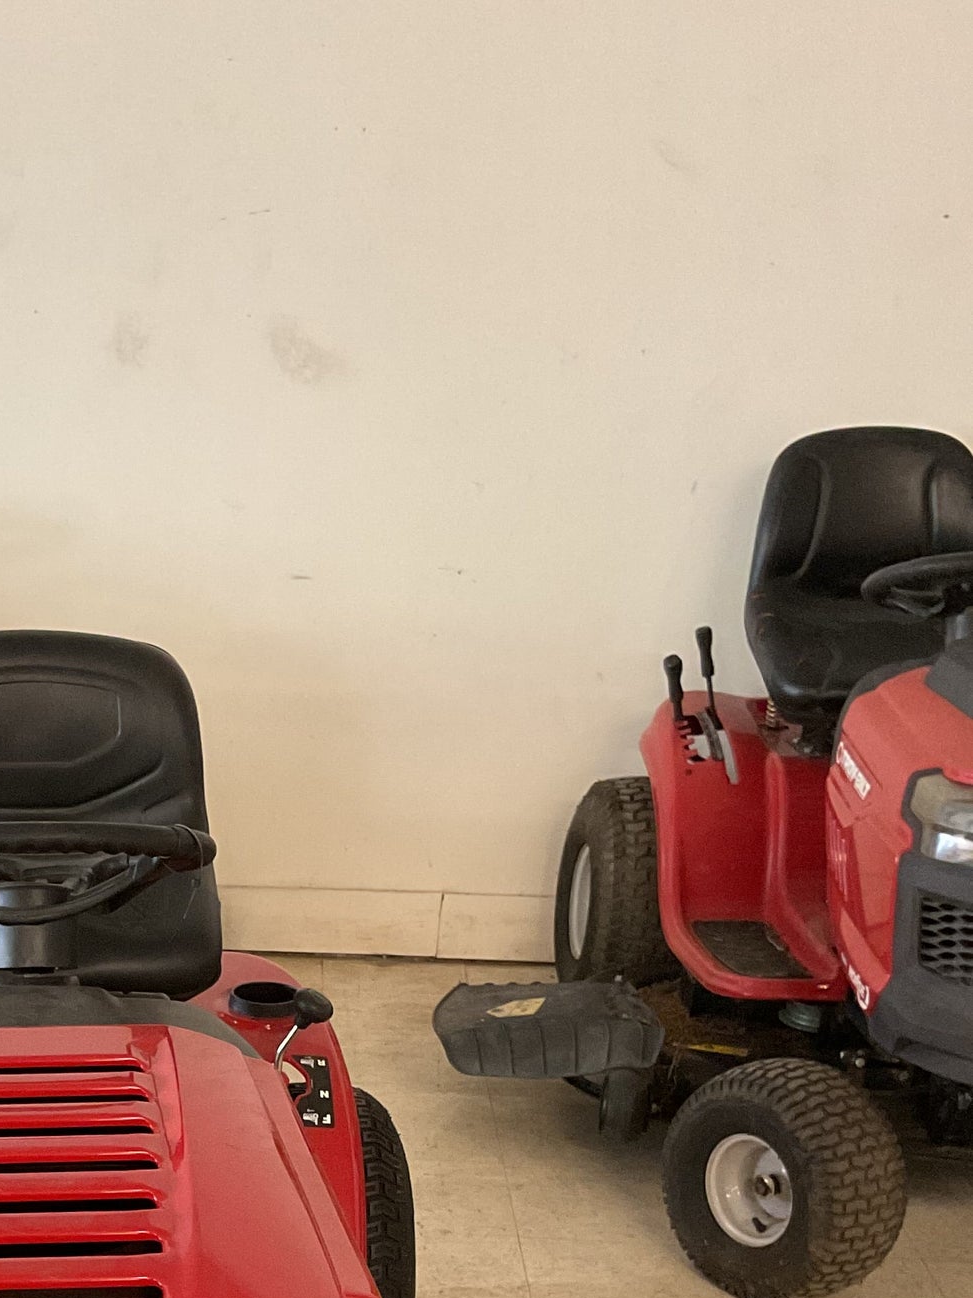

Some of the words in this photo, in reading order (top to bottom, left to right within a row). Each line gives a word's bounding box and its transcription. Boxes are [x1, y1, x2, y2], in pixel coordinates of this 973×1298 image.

[317, 1059, 326, 1067] R
[320, 1090, 329, 1098] N
[322, 1114, 331, 1124] F
